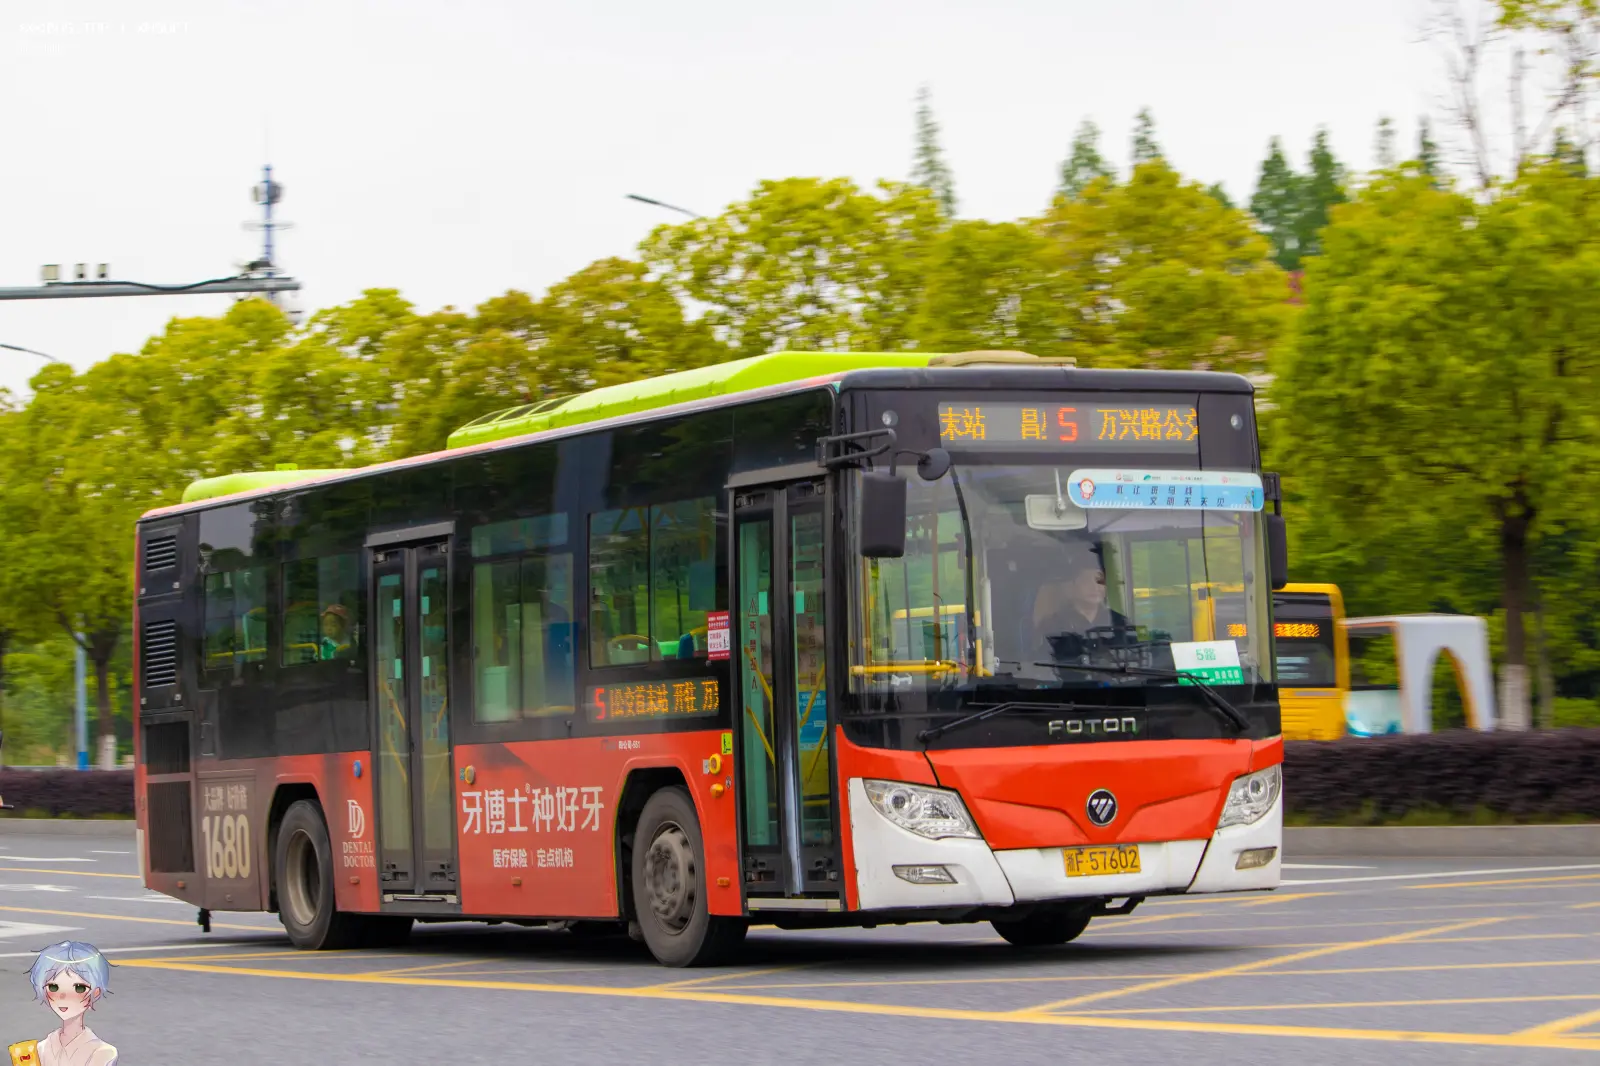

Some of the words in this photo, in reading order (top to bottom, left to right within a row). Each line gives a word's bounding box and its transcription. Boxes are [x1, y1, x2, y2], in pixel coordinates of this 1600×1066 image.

[940, 407, 985, 440] 末站
[1021, 408, 1047, 440] 昌
[1059, 407, 1077, 441] 5
[594, 687, 605, 720] 5
[1048, 717, 1137, 735] FOTON
[202, 814, 250, 879] 1680
[342, 841, 374, 854] DENTAL
[343, 855, 376, 868] DOCTOR
